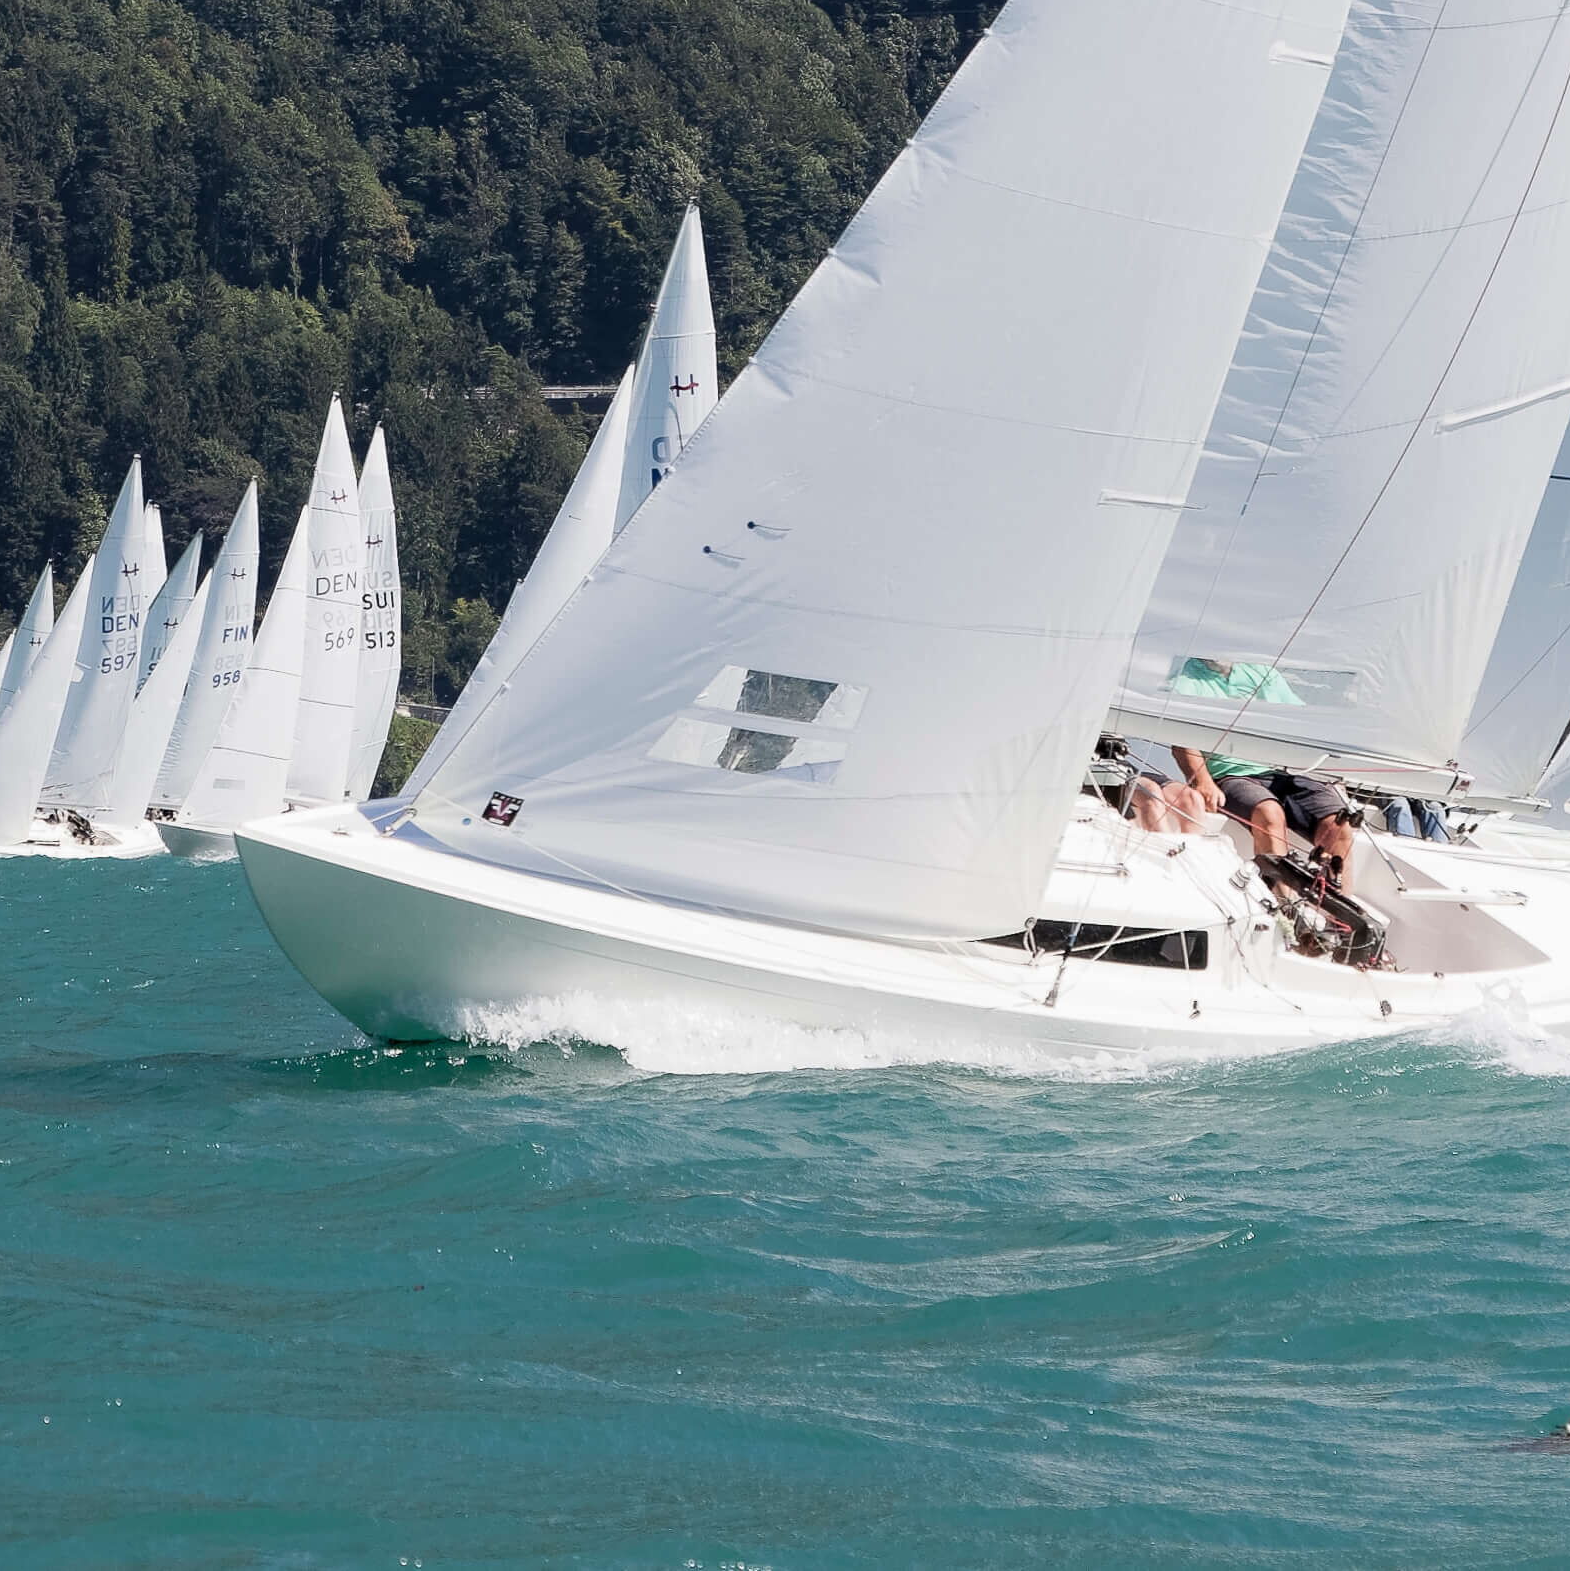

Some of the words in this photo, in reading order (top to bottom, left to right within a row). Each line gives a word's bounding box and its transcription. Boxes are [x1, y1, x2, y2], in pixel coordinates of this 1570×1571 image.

[316, 571, 357, 596] DEN
[361, 591, 395, 610] SUI
[102, 612, 140, 634] DEN
[222, 625, 249, 643] FIN
[324, 627, 355, 651] 569
[365, 631, 395, 649] 513
[100, 652, 137, 674] 597
[212, 670, 241, 688] 958
